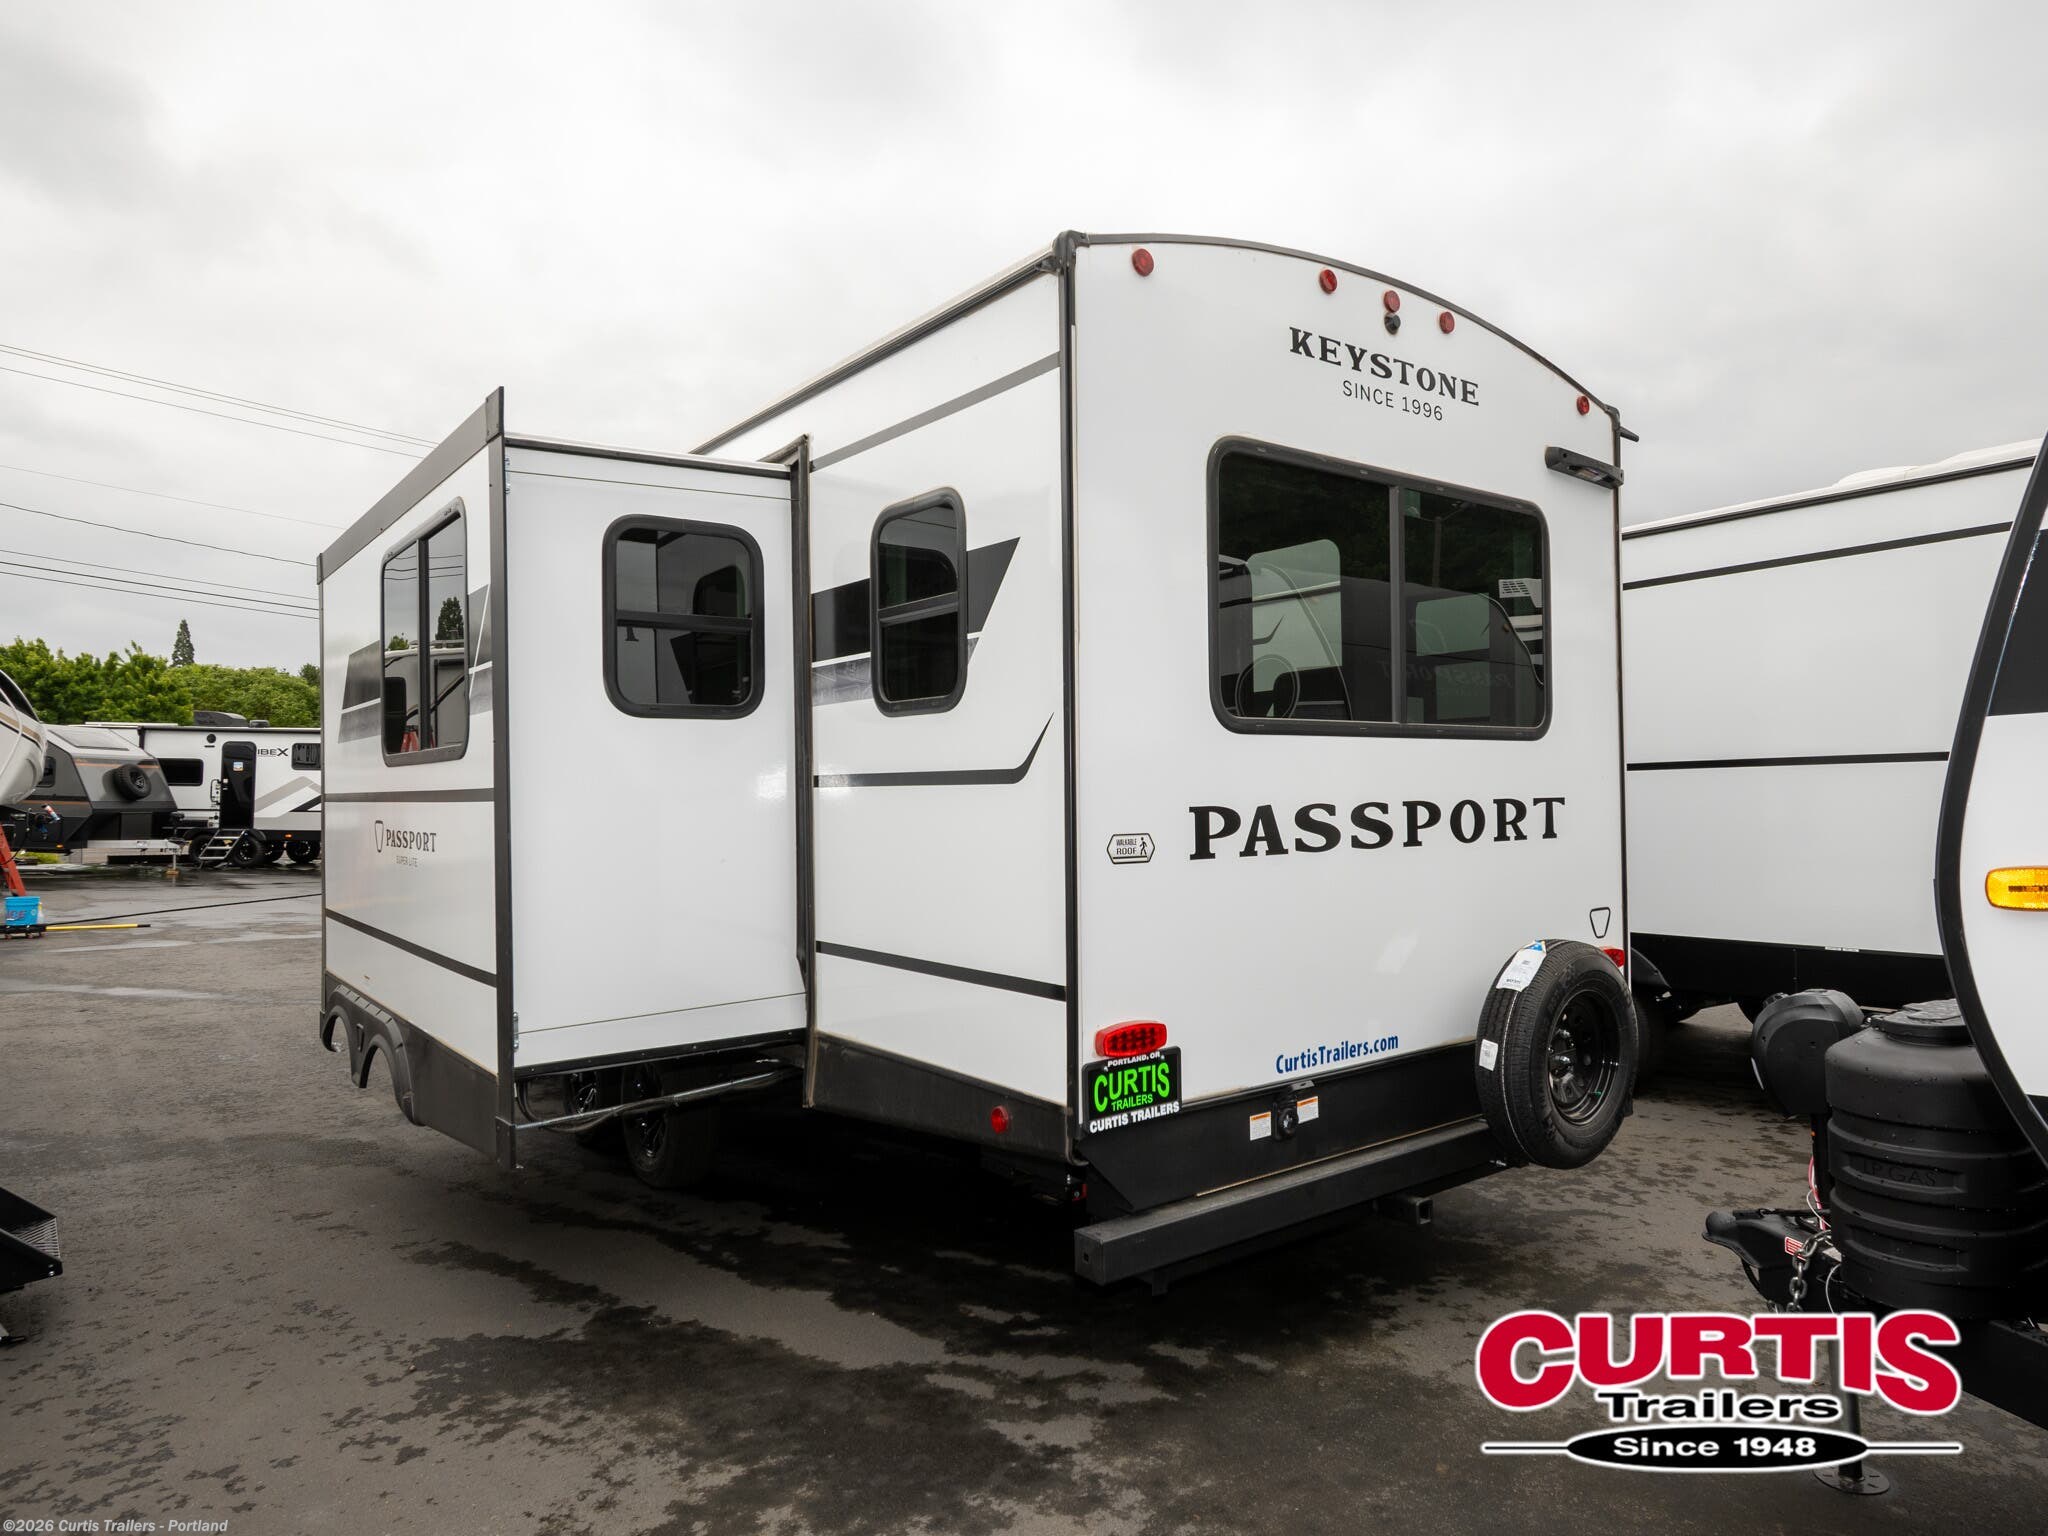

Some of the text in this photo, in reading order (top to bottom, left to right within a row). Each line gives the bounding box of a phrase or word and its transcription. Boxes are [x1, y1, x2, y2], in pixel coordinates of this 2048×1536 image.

[1289, 327, 1480, 406] KEYSTONE
[1343, 380, 1443, 421] SINCE 1996
[257, 747, 289, 757] IBEX
[386, 828, 437, 853] PASSPORT
[1116, 838, 1137, 846] WALKABLE
[1188, 796, 1566, 861] PASSPORT
[1116, 847, 1137, 855] ROOF
[1275, 1035, 1400, 1075] CurtisTrailers.com
[1094, 1061, 1171, 1113] CURTIS
[1089, 1101, 1180, 1134] CURTIS TRAILERS
[1111, 1094, 1154, 1112] TRAILERS
[1863, 1158, 1938, 1187] LP GAS
